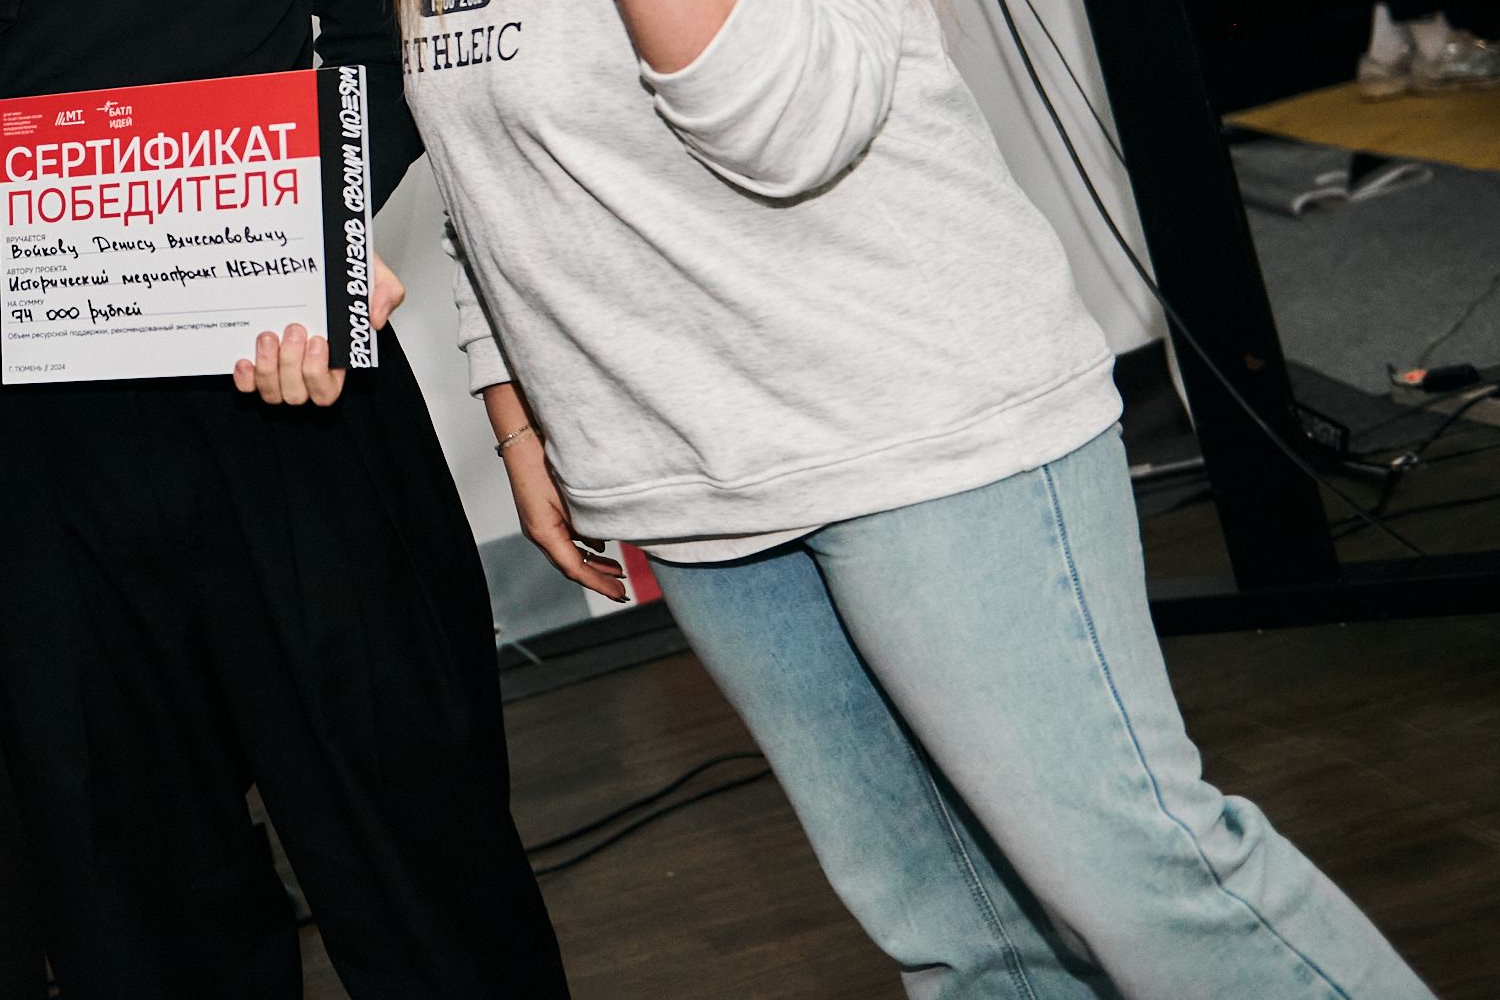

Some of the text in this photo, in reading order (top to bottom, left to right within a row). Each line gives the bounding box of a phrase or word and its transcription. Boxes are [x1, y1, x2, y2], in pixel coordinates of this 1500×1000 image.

[109, 106, 132, 117] БАТЛ
[110, 117, 132, 129] ИДЕЙ
[5, 122, 296, 182] СЕРТИФИКАТ
[8, 169, 298, 226] ПОБЕДИТЕЛЯ
[5, 234, 46, 243] ВРУЧАЕТСЯ
[92, 236, 156, 253] Денису
[6, 265, 67, 276] АВТОРУ ПРОЕКТА
[9, 269, 109, 294] Исторический
[226, 257, 318, 278] MEDMEDIA
[7, 299, 45, 308] НА СУММУ
[11, 299, 142, 325] 74 000 рублей
[50, 363, 66, 371] 2024
